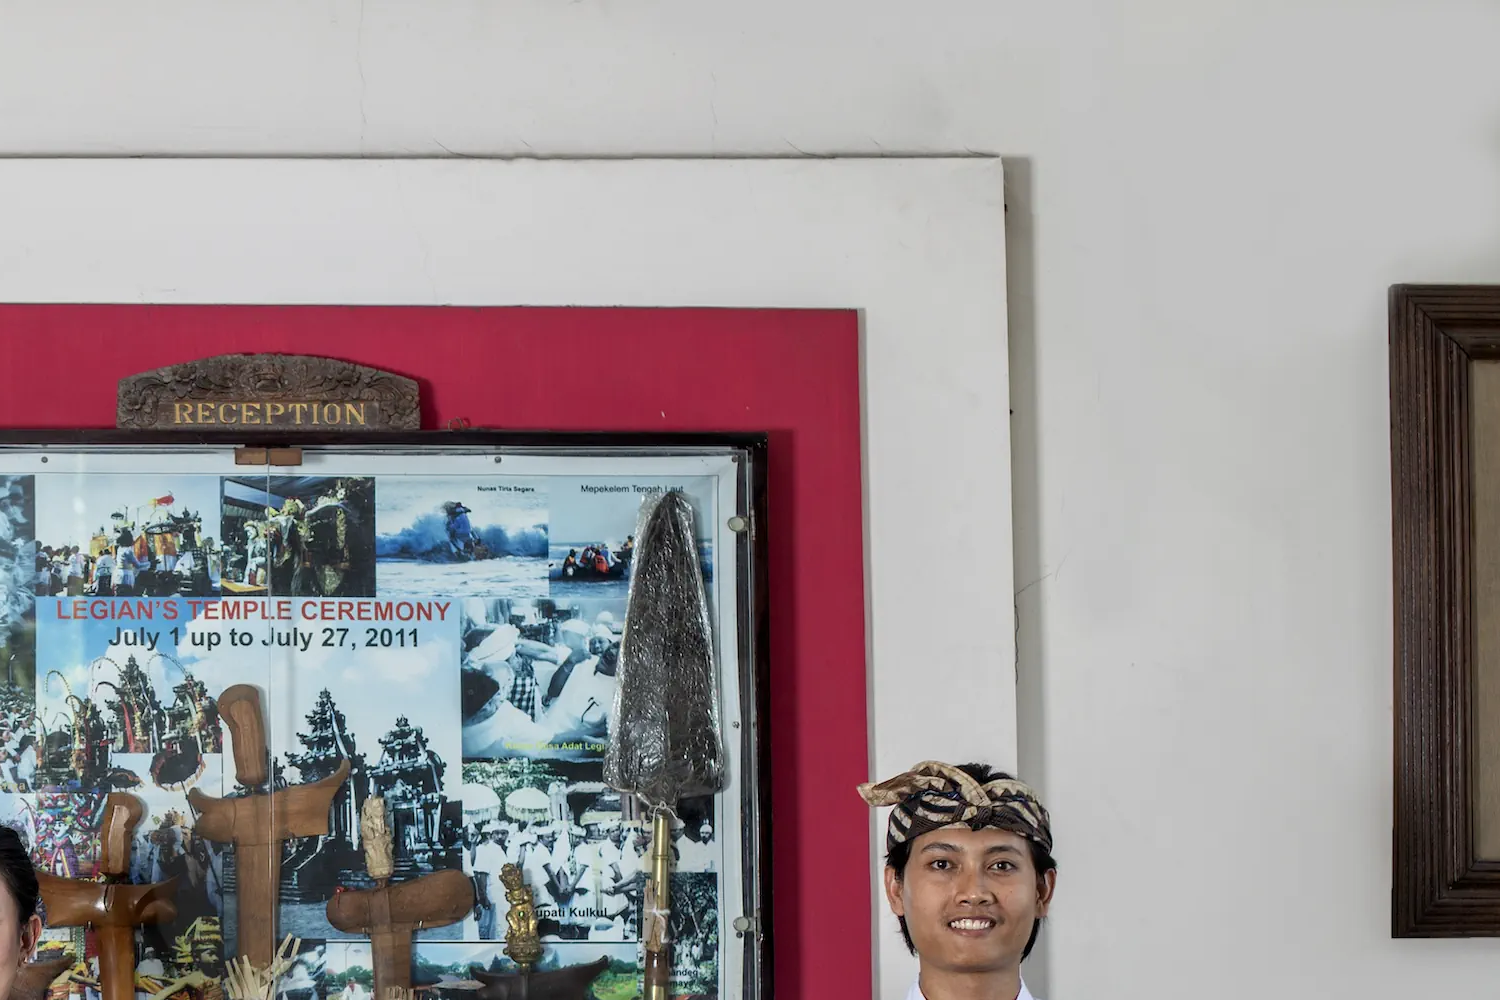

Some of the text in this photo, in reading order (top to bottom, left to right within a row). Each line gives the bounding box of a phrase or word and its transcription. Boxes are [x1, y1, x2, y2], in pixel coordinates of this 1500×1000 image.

[174, 402, 366, 425] RECEPTION
[580, 484, 630, 495] Mepekelem
[631, 484, 663, 495] Tengah
[56, 600, 452, 621] LEGIAN'S TEMPLE CEREMONY
[108, 627, 419, 652] July 1 up to July 27, 2011
[561, 741, 583, 750] Adat
[585, 741, 604, 752] Legi
[535, 907, 607, 920] upati Kulkul
